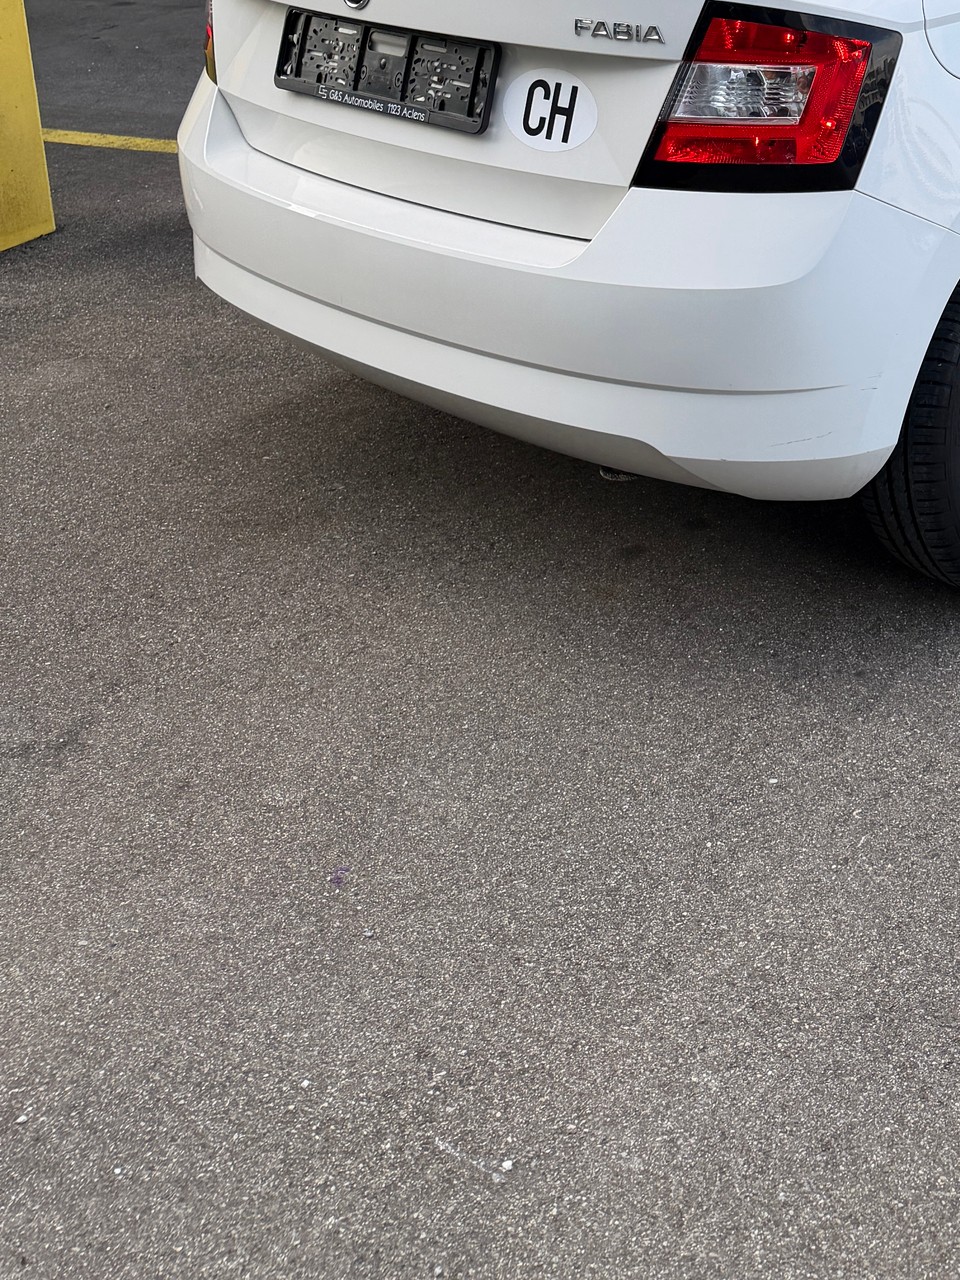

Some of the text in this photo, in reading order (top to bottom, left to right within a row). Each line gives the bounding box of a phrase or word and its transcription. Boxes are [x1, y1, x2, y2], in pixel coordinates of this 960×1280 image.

[574, 18, 665, 44] FABIA
[329, 89, 343, 101] G&S
[342, 94, 384, 112] Automobiles
[387, 103, 401, 115] 1123
[401, 107, 425, 122] Aclens
[523, 79, 578, 144] CH
